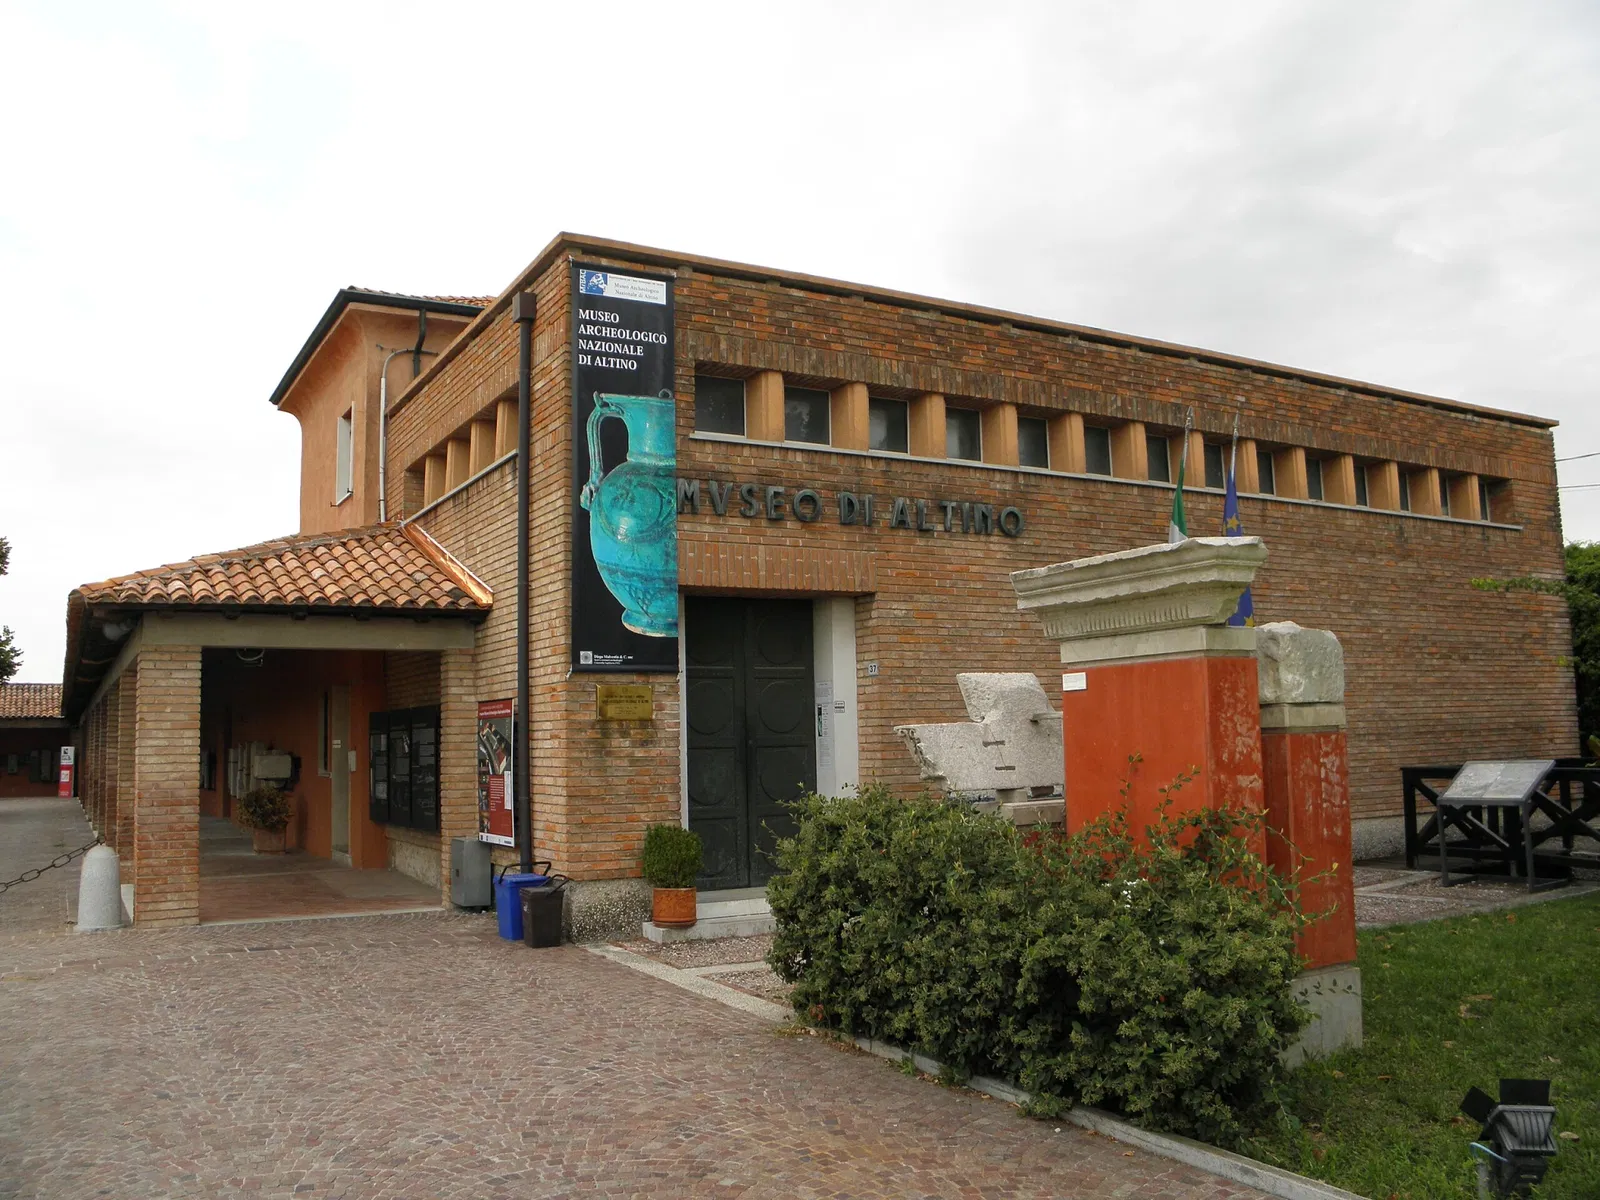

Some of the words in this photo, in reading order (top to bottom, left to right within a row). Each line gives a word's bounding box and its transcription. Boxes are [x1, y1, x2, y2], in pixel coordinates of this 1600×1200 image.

[614, 282, 630, 290] Museo
[630, 285, 660, 294] Archeologico
[615, 289, 637, 297] Nazionale
[579, 309, 619, 323] MUSEO
[578, 324, 667, 344] ARCHEOLOGICO
[578, 339, 644, 356] NAZIONALE
[578, 354, 592, 366] DI
[594, 356, 637, 371] ALTINO
[677, 478, 822, 522] MVSEO
[839, 492, 873, 527] DI
[890, 497, 1024, 537] ALTINO
[869, 664, 877, 673] 37
